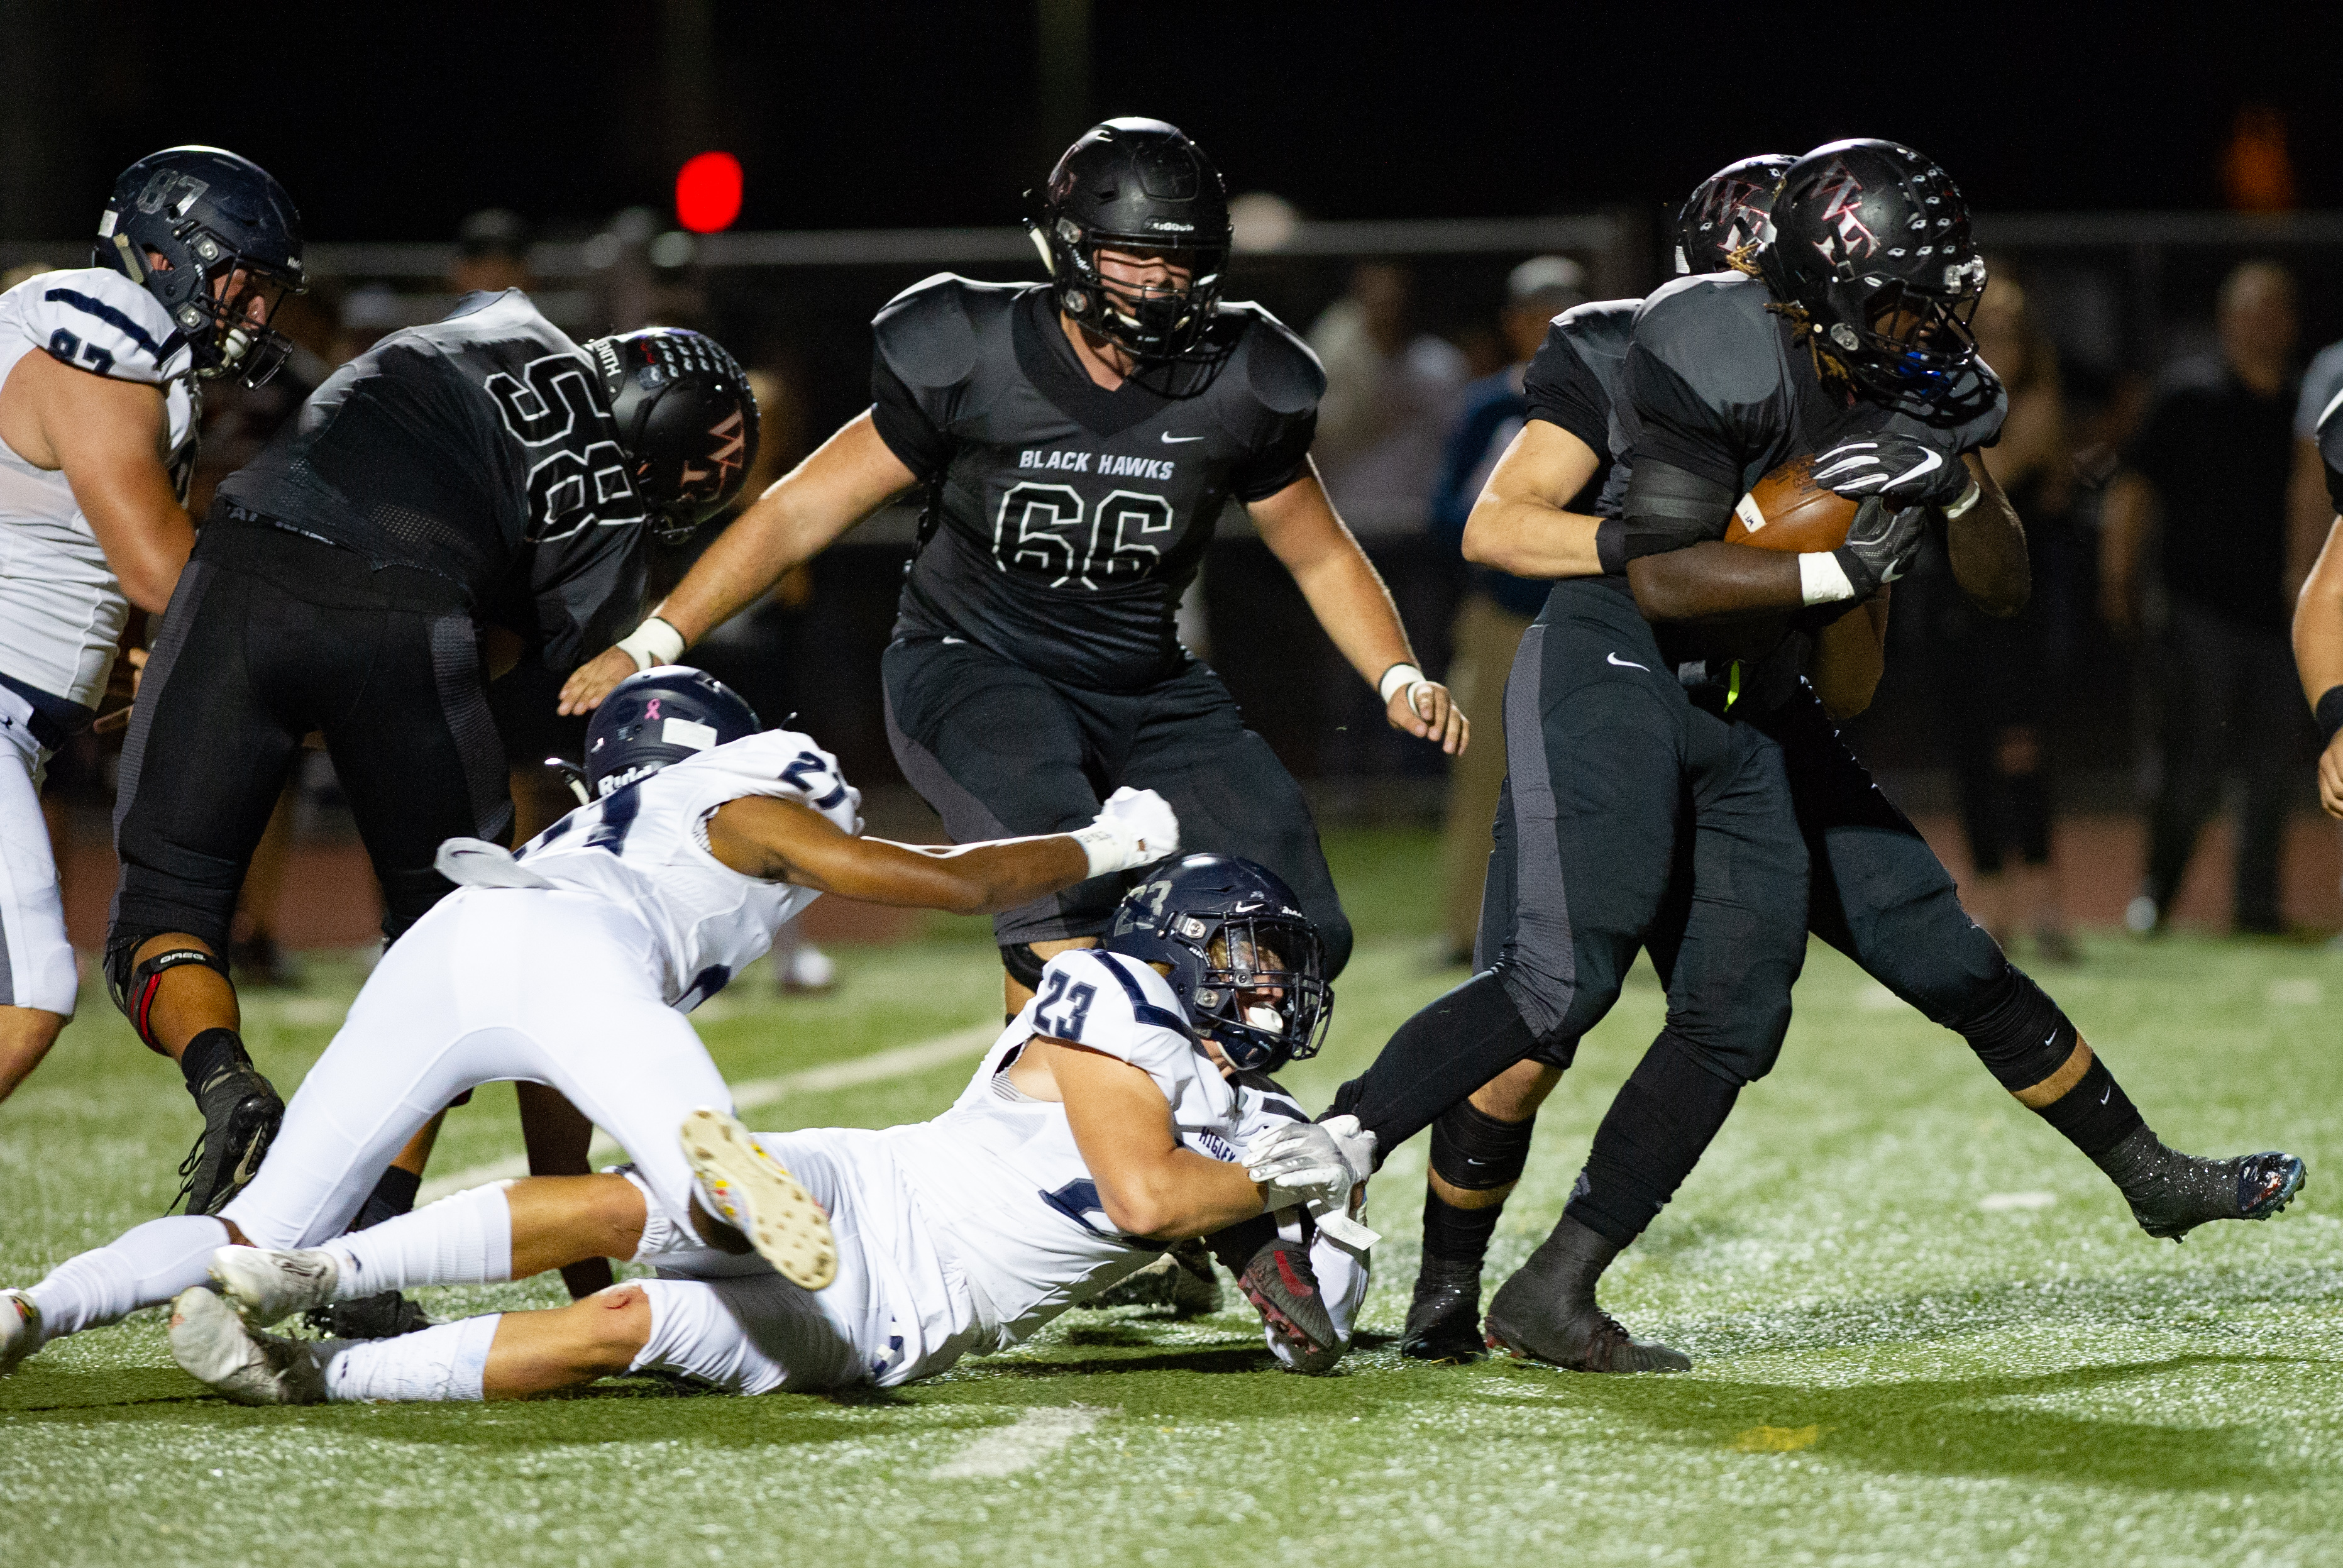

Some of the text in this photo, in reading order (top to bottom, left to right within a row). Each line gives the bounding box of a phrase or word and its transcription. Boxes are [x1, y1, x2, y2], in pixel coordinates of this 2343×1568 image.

[136, 168, 211, 217] 87
[484, 352, 646, 543] 58
[1019, 450, 1175, 480] BLACK HAWKS
[992, 482, 1174, 591] 66
[1113, 880, 1173, 937] 23
[1033, 968, 1098, 1042] 23
